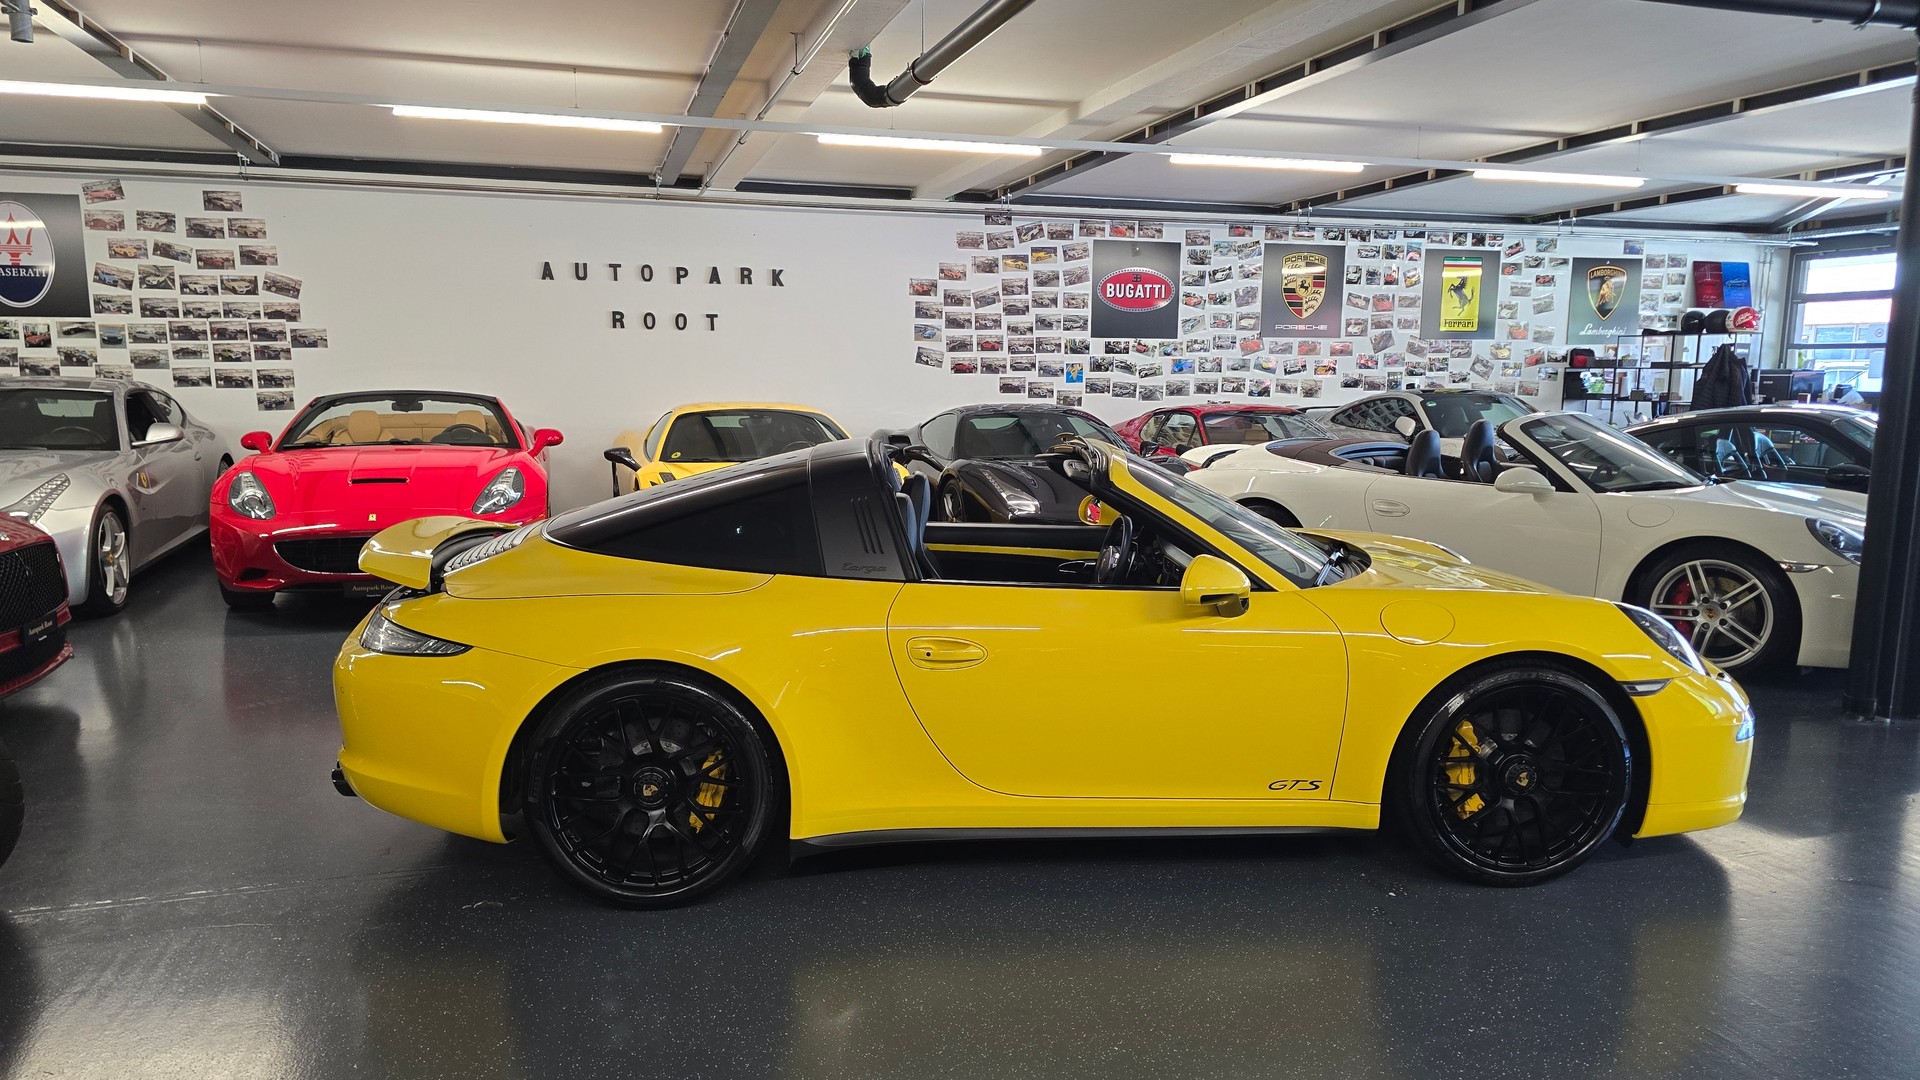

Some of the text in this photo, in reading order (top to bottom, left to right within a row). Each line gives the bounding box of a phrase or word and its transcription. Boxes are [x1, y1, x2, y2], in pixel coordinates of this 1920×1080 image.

[1284, 255, 1326, 265] PORSCHE
[541, 261, 785, 287] AUTOPARK
[1106, 283, 1166, 299] BUGATTI
[611, 310, 719, 331] ROOT
[1443, 318, 1475, 328] Ferrari
[1579, 323, 1627, 337] Lamborghini
[1268, 779, 1323, 791] GTS
